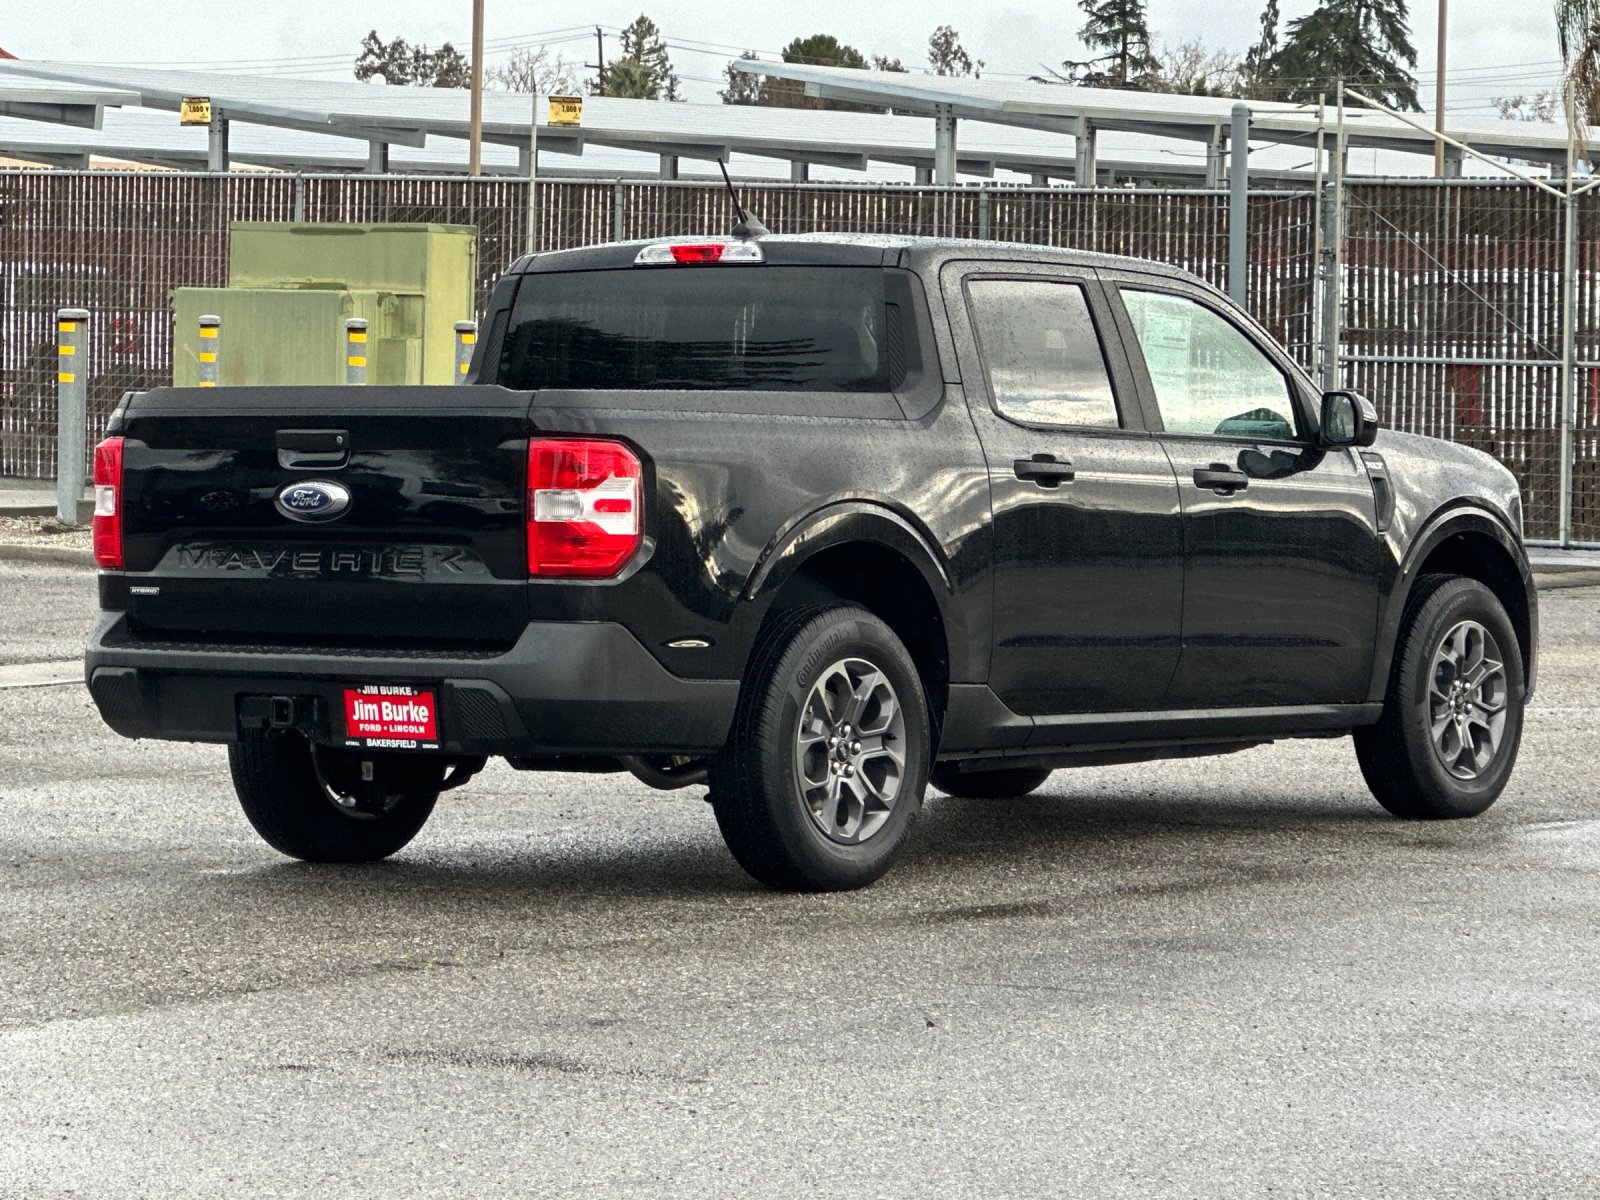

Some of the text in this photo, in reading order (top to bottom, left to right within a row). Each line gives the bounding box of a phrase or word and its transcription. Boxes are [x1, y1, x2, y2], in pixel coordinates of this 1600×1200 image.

[291, 490, 320, 506] Ford
[178, 548, 465, 575] MAVERICK
[362, 685, 412, 696] JIM BURKE
[353, 699, 429, 723] Jim Burke
[359, 723, 425, 734] FORD LINCOLN
[366, 738, 417, 749] BAKERSFIELD
